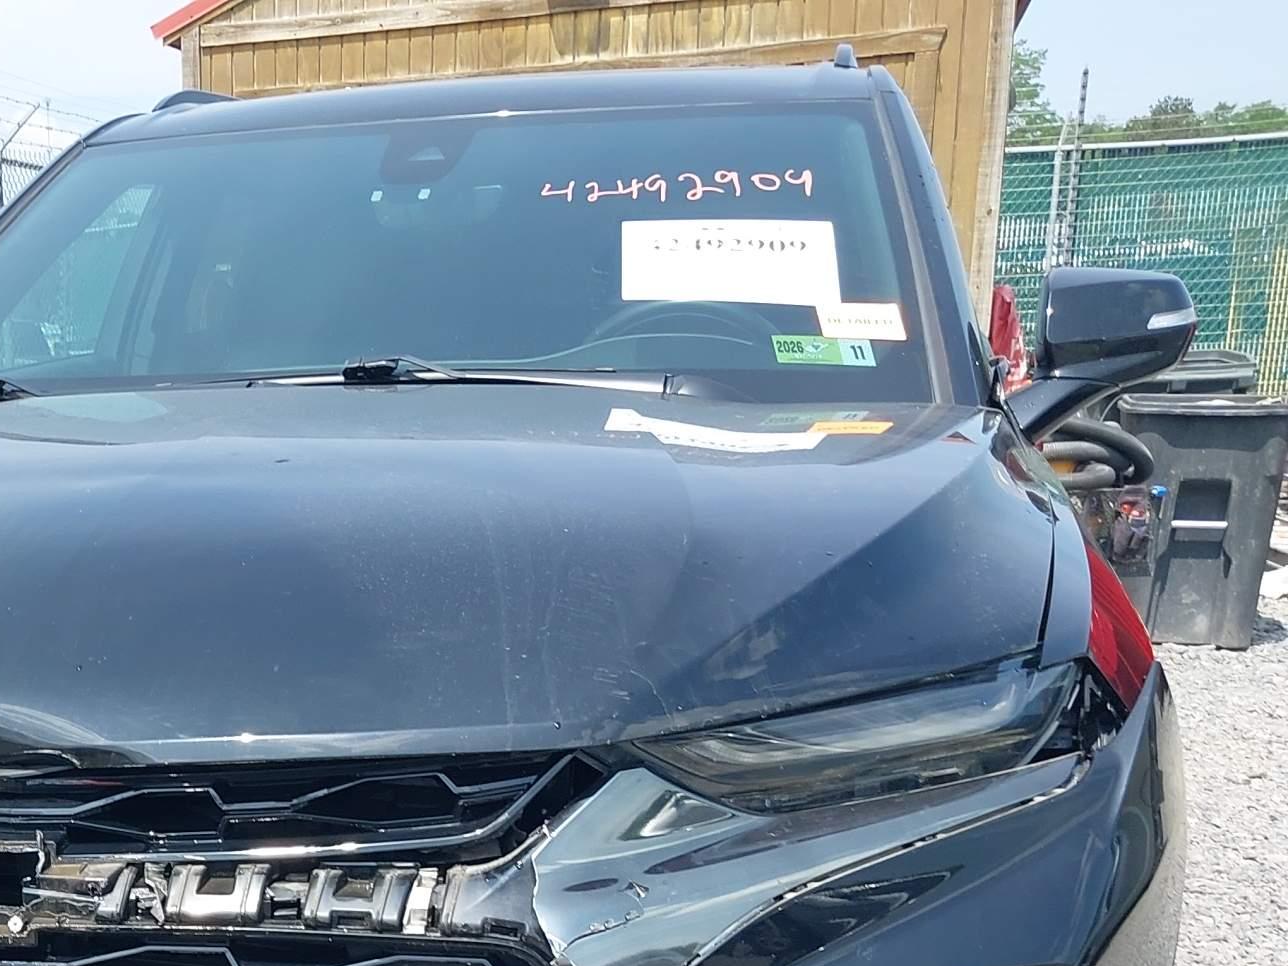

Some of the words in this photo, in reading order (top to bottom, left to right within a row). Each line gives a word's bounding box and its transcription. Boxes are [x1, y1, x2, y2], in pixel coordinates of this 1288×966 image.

[541, 169, 813, 202] 42492909
[776, 340, 804, 354] 2026
[850, 345, 867, 360] 11
